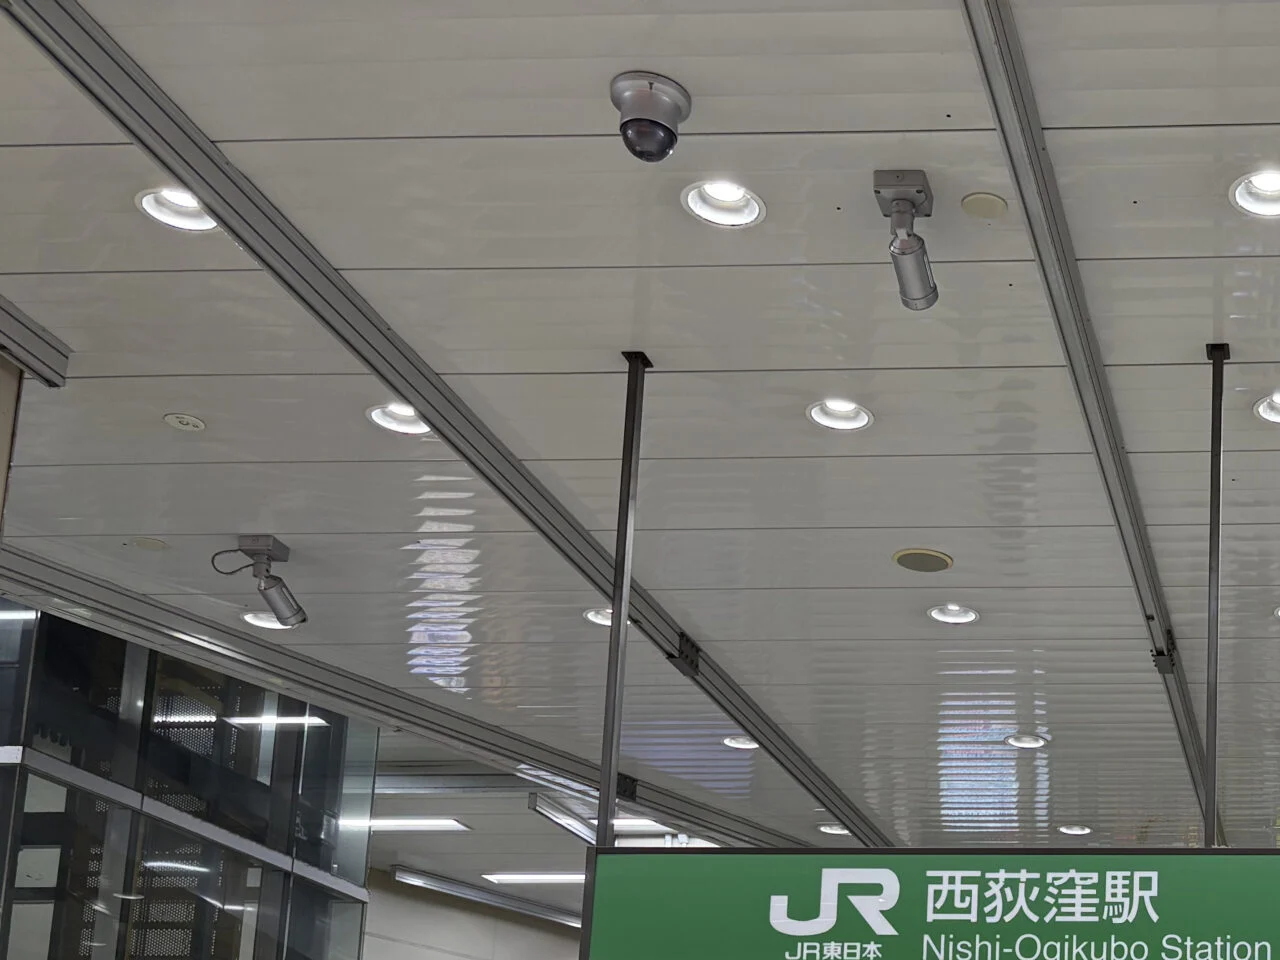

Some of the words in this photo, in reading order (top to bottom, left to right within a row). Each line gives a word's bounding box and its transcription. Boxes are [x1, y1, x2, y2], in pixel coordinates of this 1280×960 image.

[769, 868, 900, 935] JR
[925, 869, 1159, 925] 西荻窪駅
[785, 941, 882, 960] JR東日本
